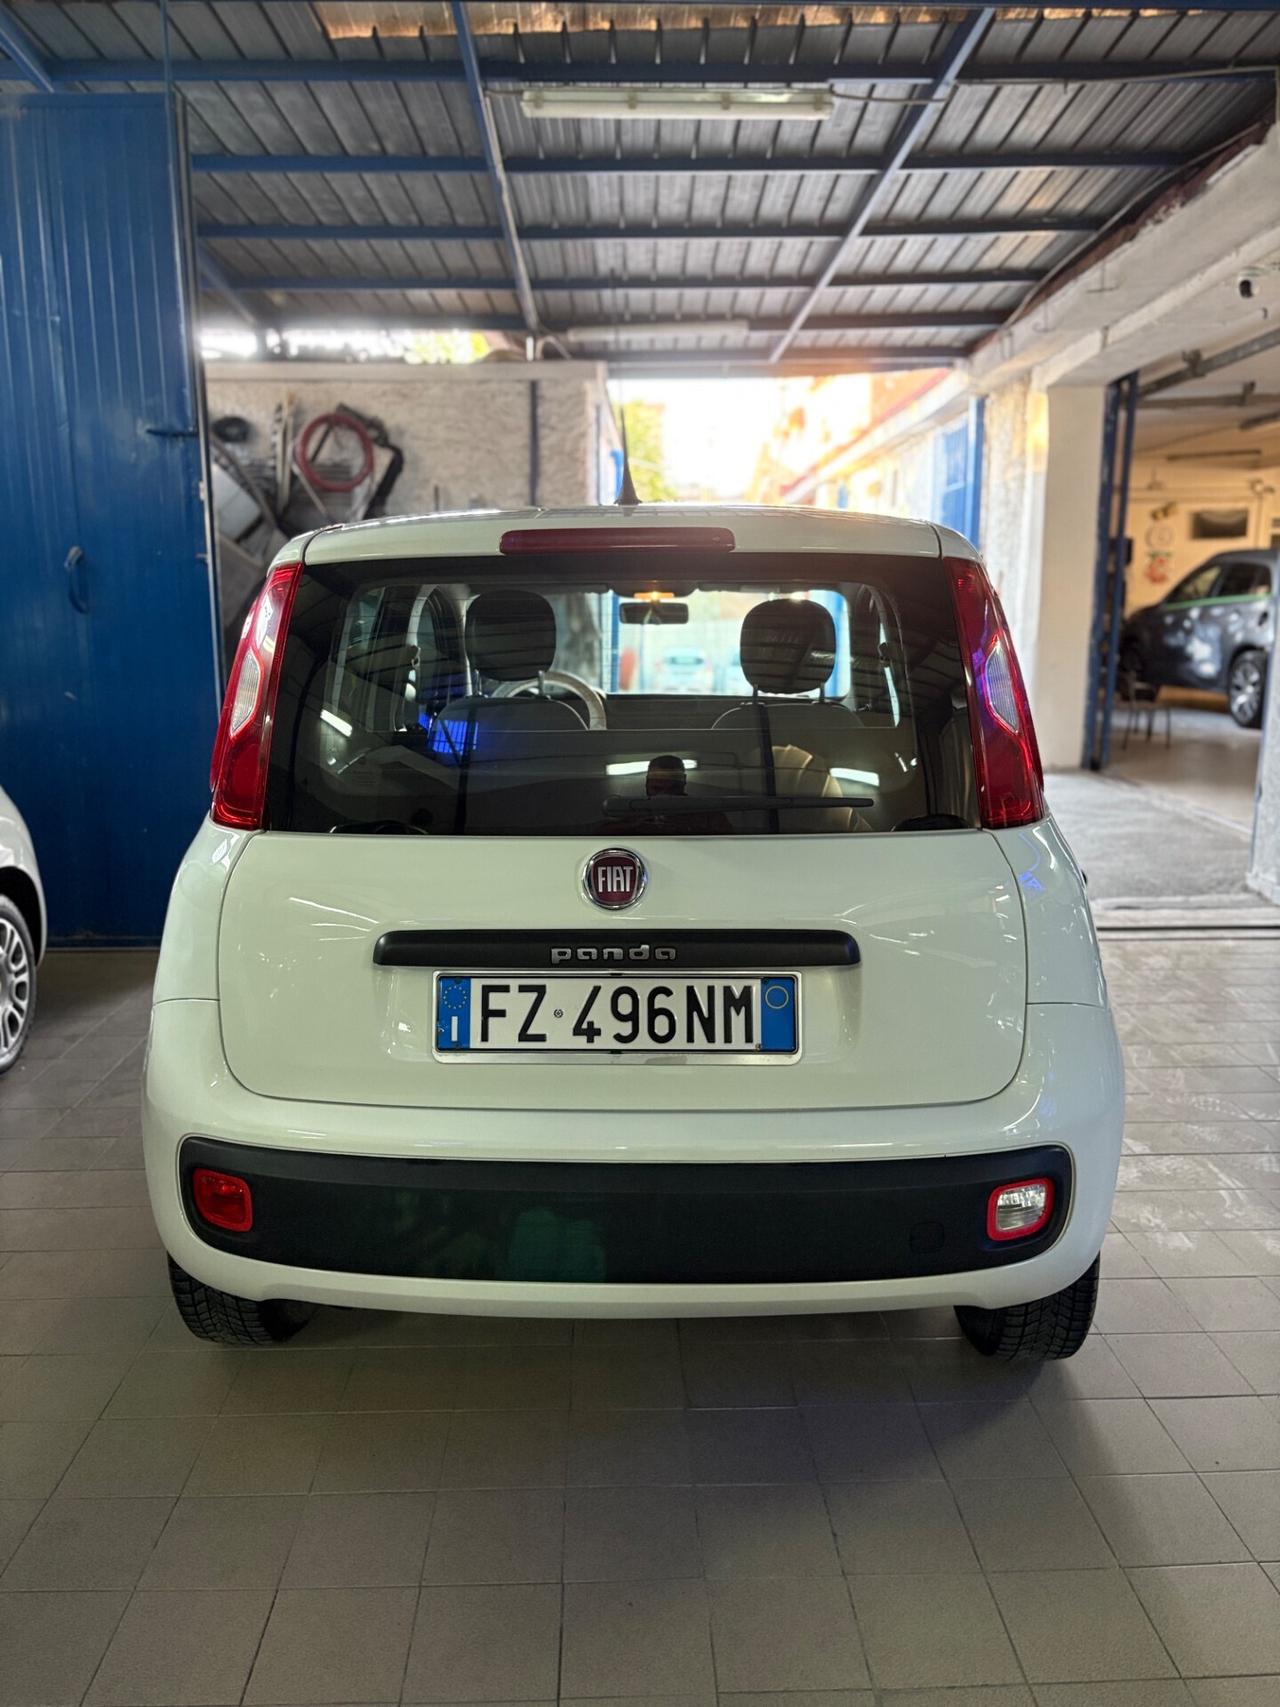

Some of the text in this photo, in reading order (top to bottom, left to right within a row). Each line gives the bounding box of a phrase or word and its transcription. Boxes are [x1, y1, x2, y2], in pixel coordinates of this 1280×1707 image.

[597, 866, 633, 892] FIAT
[551, 945, 677, 964] panda
[480, 984, 754, 1044] FZ 496NM
